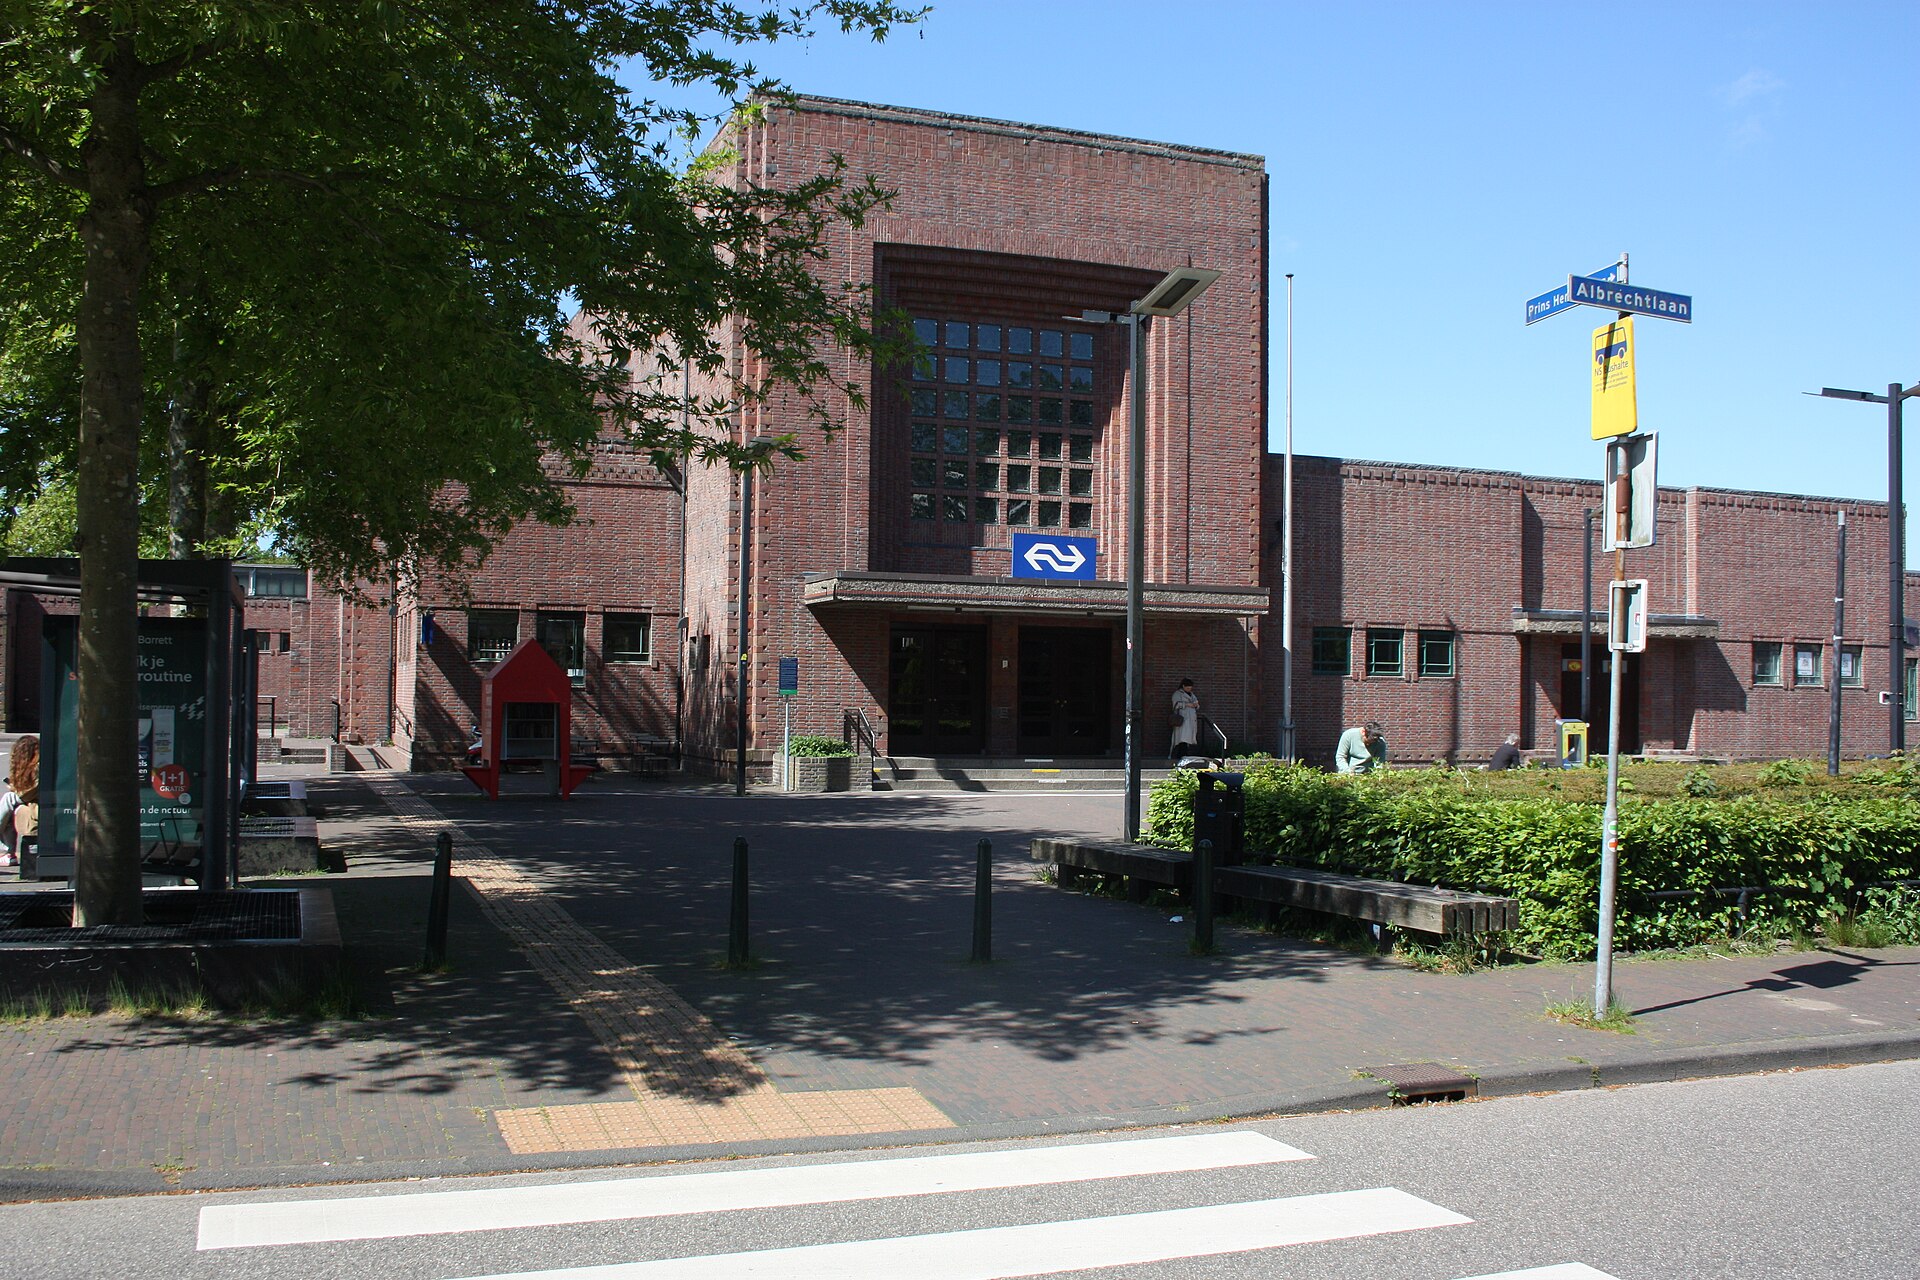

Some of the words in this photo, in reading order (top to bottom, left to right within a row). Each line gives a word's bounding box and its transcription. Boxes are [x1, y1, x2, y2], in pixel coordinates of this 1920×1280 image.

[1576, 282, 1688, 315] Albrechtlaan
[1528, 301, 1551, 317] Prins
[137, 635, 173, 645] Barrett
[150, 655, 165, 670] je
[137, 670, 193, 683] routine
[160, 771, 185, 785] 1+1
[148, 805, 160, 814] de
